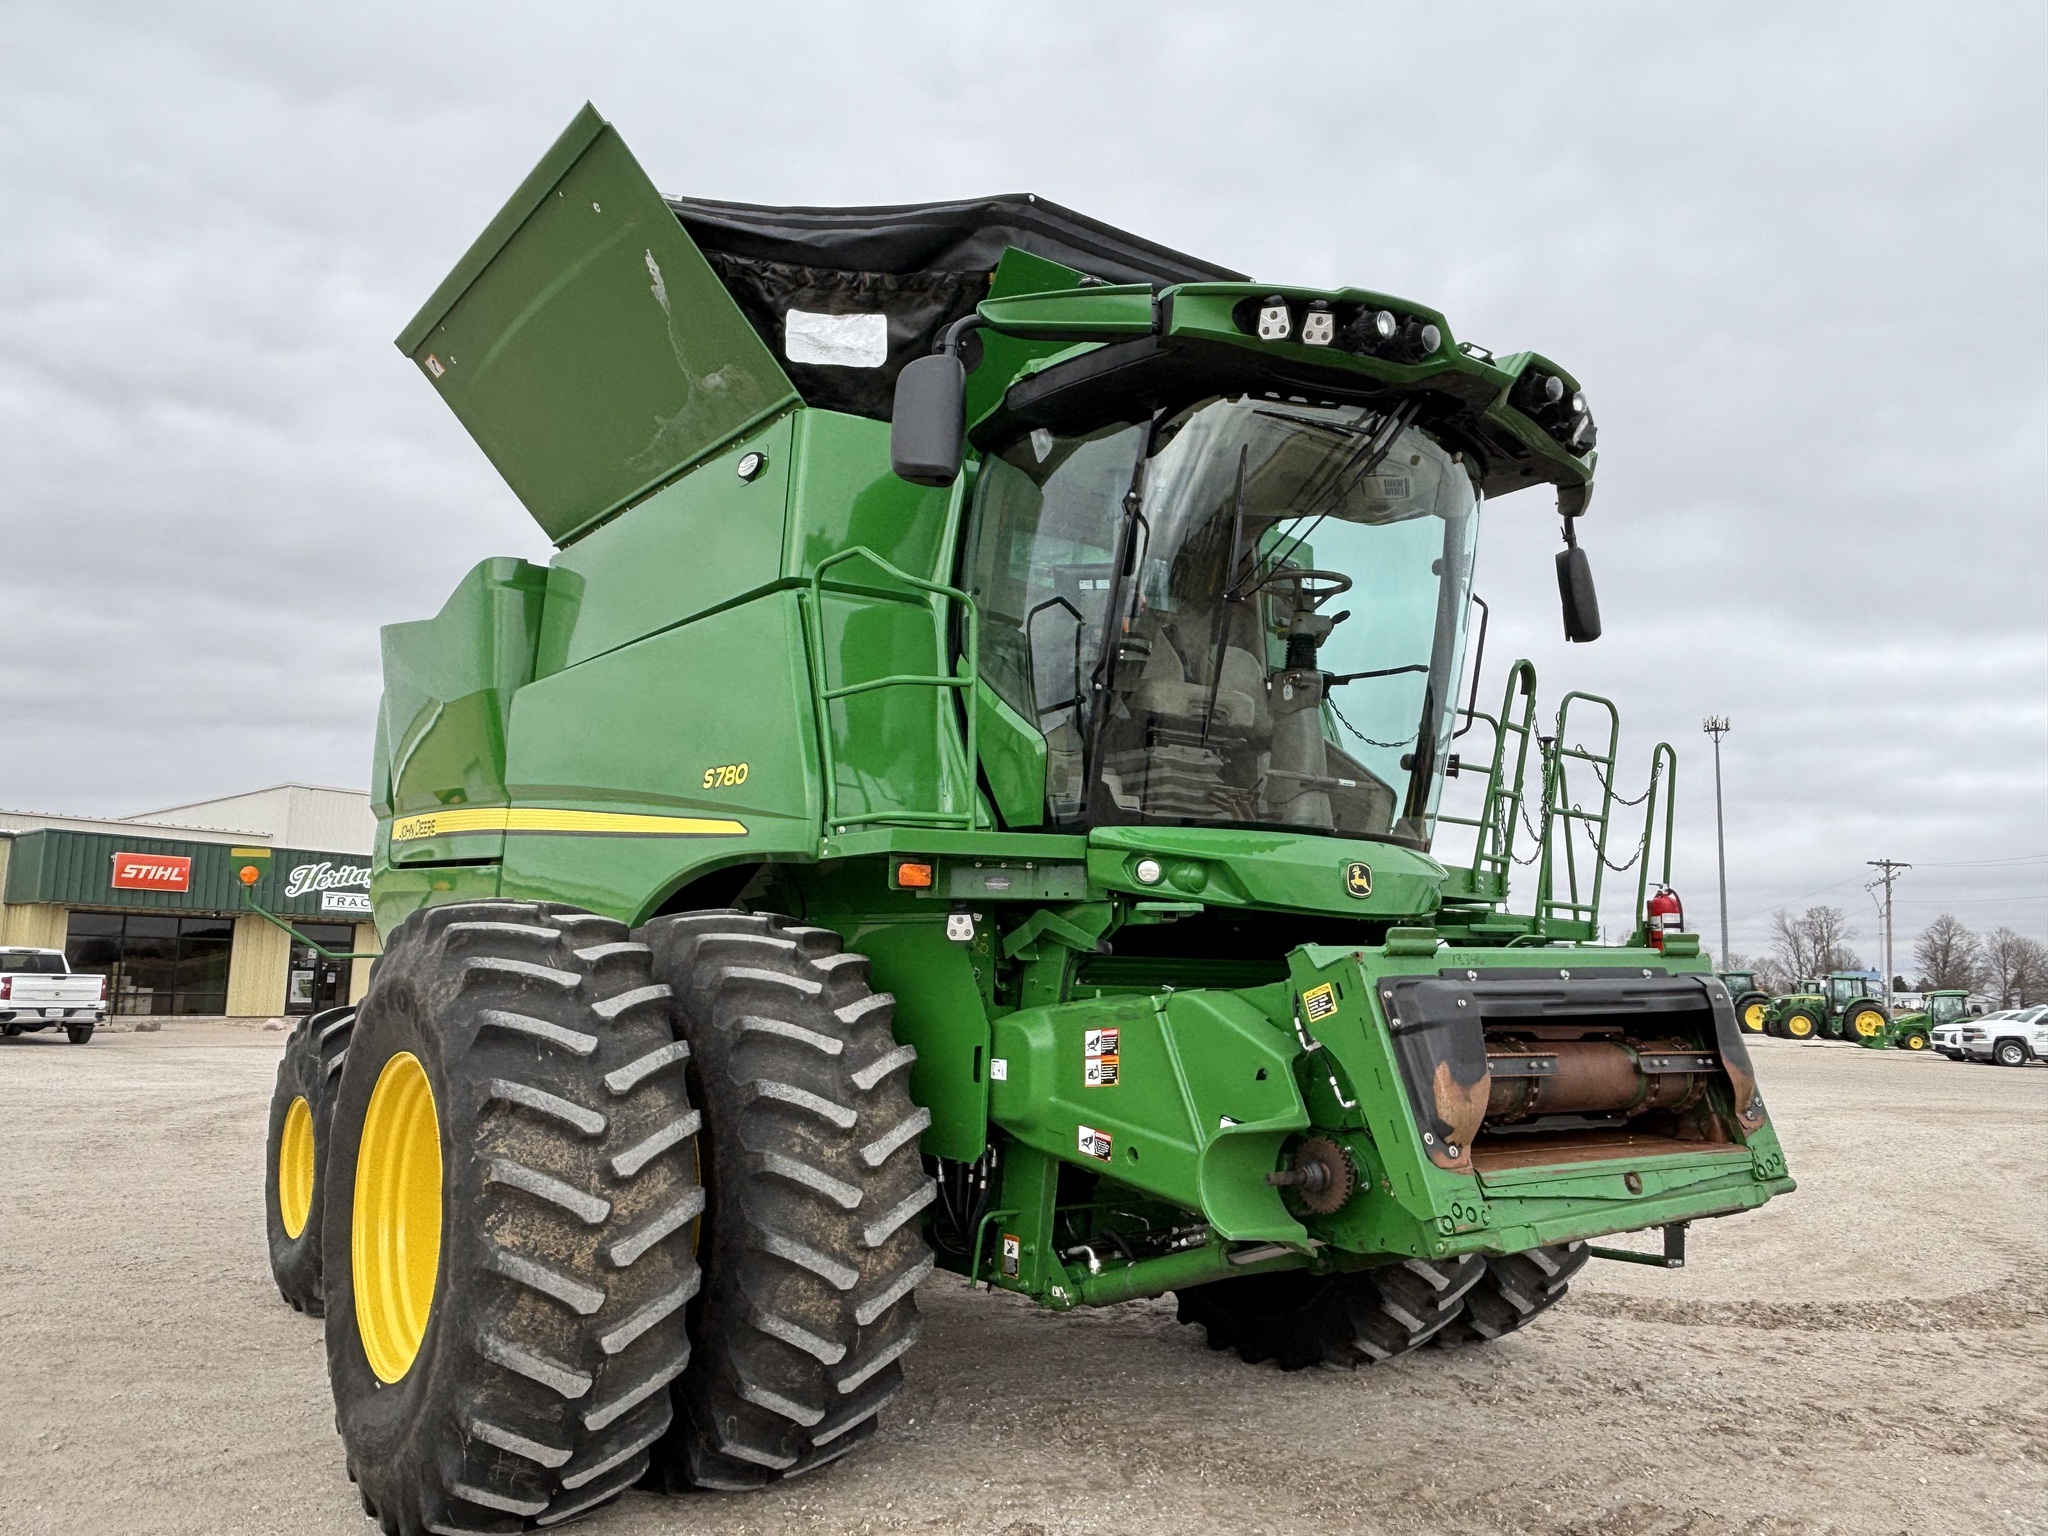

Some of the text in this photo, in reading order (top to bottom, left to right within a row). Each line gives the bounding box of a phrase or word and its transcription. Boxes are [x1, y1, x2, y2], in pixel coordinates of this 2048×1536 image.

[703, 762, 749, 789] S780
[121, 864, 183, 881] STIHL
[285, 862, 372, 897] Herita
[325, 895, 370, 908] TRAC
